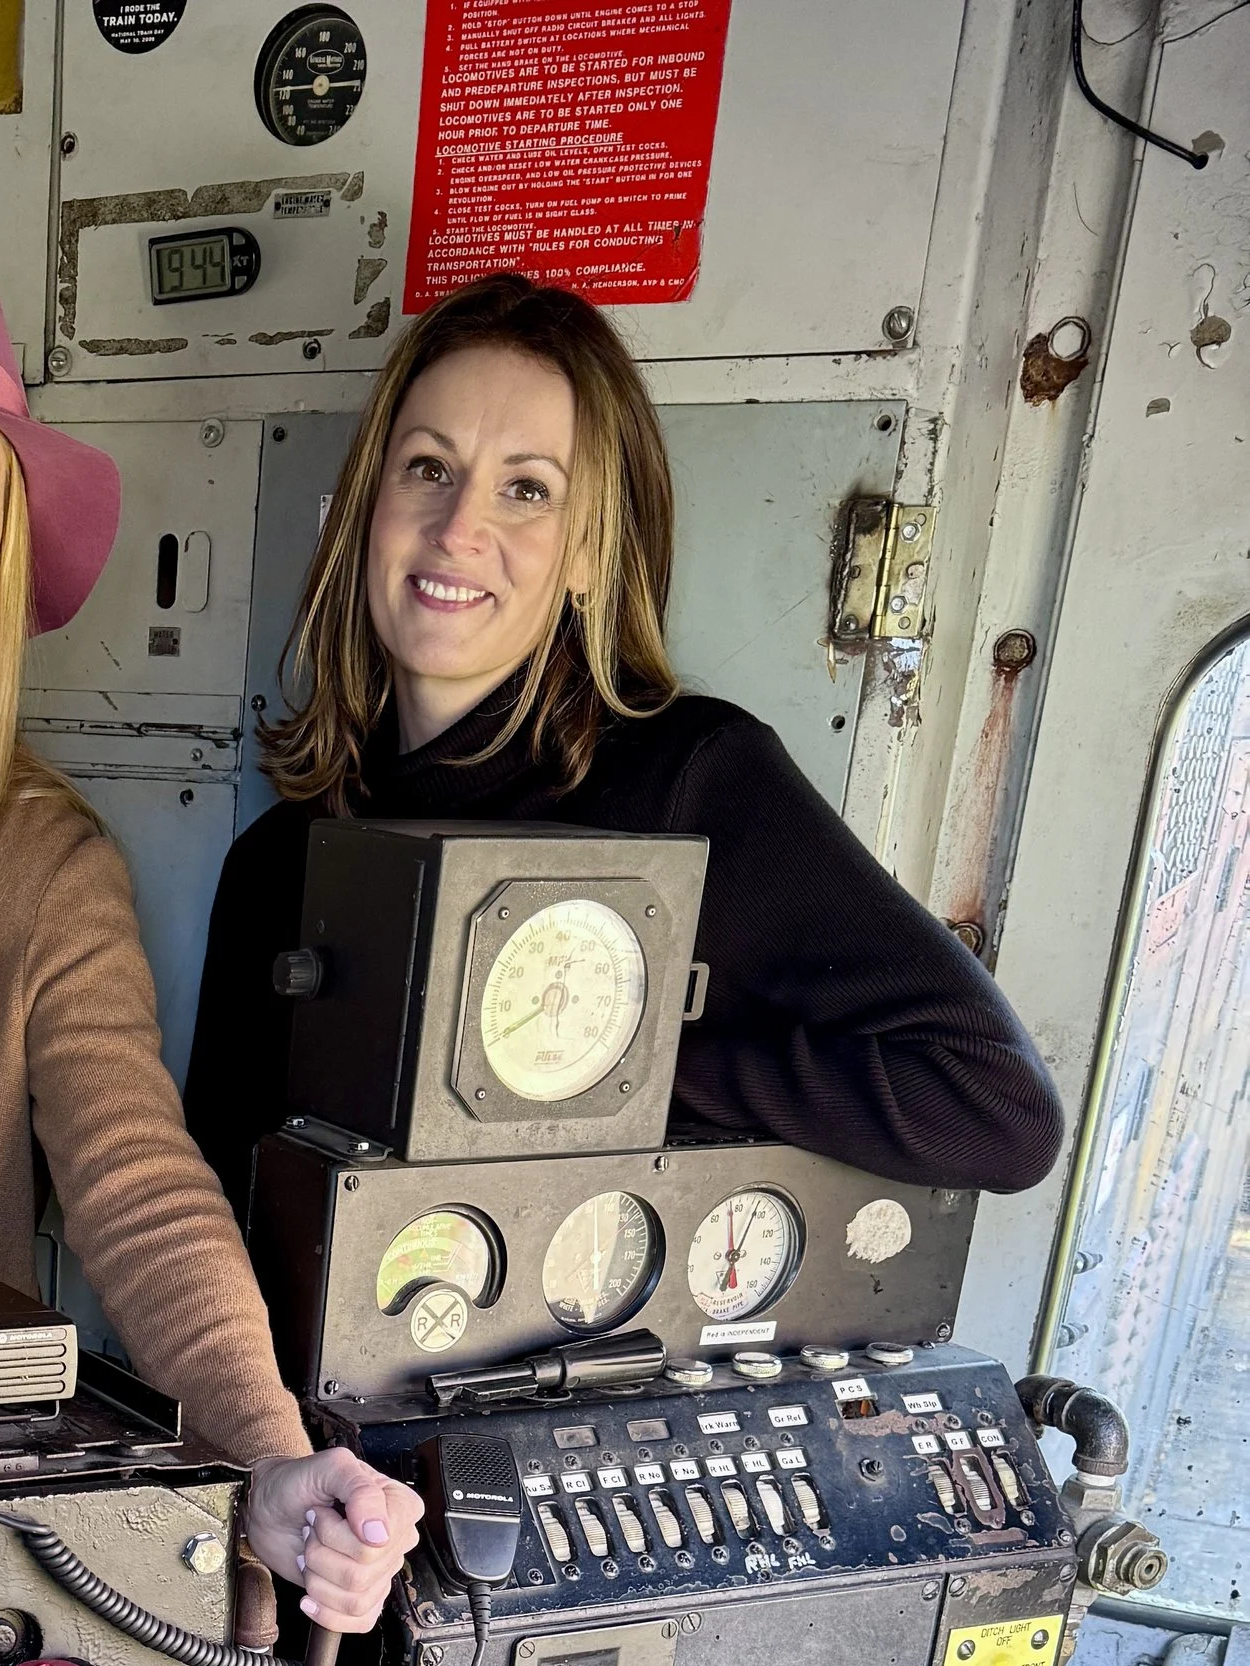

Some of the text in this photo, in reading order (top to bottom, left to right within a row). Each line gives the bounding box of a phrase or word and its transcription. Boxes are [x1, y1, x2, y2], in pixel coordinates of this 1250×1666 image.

[125, 4, 145, 12] RODE
[146, 3, 161, 11] THE
[102, 12, 178, 26] TRAIN TODAY.
[319, 32, 330, 42] 180
[344, 42, 357, 53] 200
[353, 60, 364, 71] 210
[442, 51, 705, 84] LOCOMOTIVES ARE TO BE STARTED FOR INBOUND
[441, 68, 697, 98] AND PREDEPARTURE INSPECTIONS, BUT MUST BE
[440, 84, 683, 112] SHUT DOWN IMMEDIATELY AFTER INSPECTION.
[438, 130, 465, 140] HOUR
[503, 126, 516, 135] TO
[520, 121, 580, 134] DEPARTURE
[585, 119, 612, 129] TIME.
[436, 132, 624, 155] LOCOMOTIVE STARTING PROCEDURE
[429, 223, 643, 245] LOCOMOTIVES MUST BE HANDLED AT ALL
[556, 931, 571, 942] 40
[529, 942, 545, 954] 30
[580, 940, 595, 952] 50
[509, 966, 524, 978] 20
[595, 963, 610, 975] 60
[499, 1000, 512, 1012] 10
[597, 996, 611, 1008] 70
[584, 1026, 598, 1038] 80
[734, 1204, 743, 1212] 80
[711, 1214, 720, 1223] 60
[755, 1211, 766, 1219] 100
[624, 1229, 635, 1238] 150
[762, 1229, 774, 1238] 120
[624, 1251, 635, 1260] 170
[760, 1257, 772, 1266] 140
[609, 1279, 621, 1288] 200
[746, 1280, 758, 1288] 160
[712, 1292, 744, 1306] RESERVOIR
[712, 1302, 744, 1315] BRAKE PIPE
[418, 1314, 461, 1331] R R
[10, 1332, 52, 1340] MOTOROLA
[727, 1328, 770, 1337] INDEPENDENT
[908, 1400, 937, 1409] Wh Slp
[787, 1414, 801, 1422] Rel
[981, 1435, 1000, 1443] CON
[466, 1493, 513, 1502] MOTOROLA
[745, 1552, 816, 1574] RHL FHL
[981, 1622, 1032, 1638] DITCH LIGHT
[996, 1636, 1012, 1646] OFF
